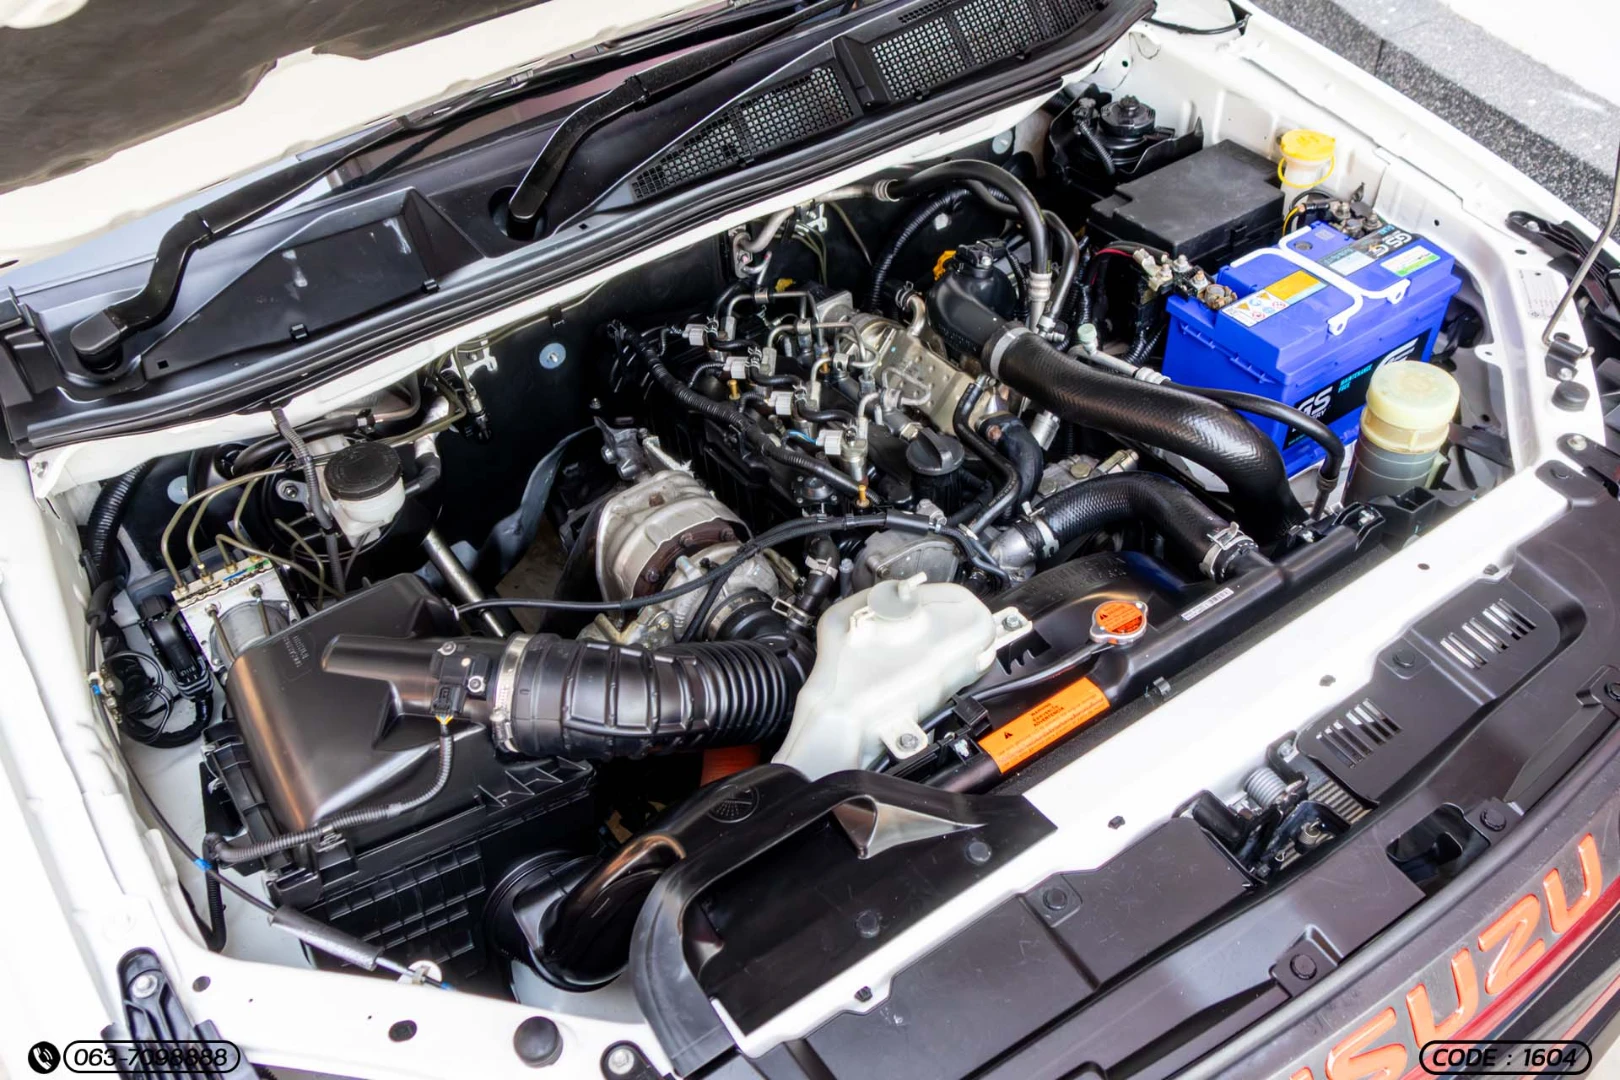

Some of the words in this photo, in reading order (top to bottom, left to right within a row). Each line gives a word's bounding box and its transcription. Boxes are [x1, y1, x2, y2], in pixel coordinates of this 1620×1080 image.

[1337, 381, 1351, 394] FREE
[1340, 363, 1373, 386] MAINTENANCE
[1297, 386, 1333, 416] GS
[1289, 832, 1603, 1080] SUZU
